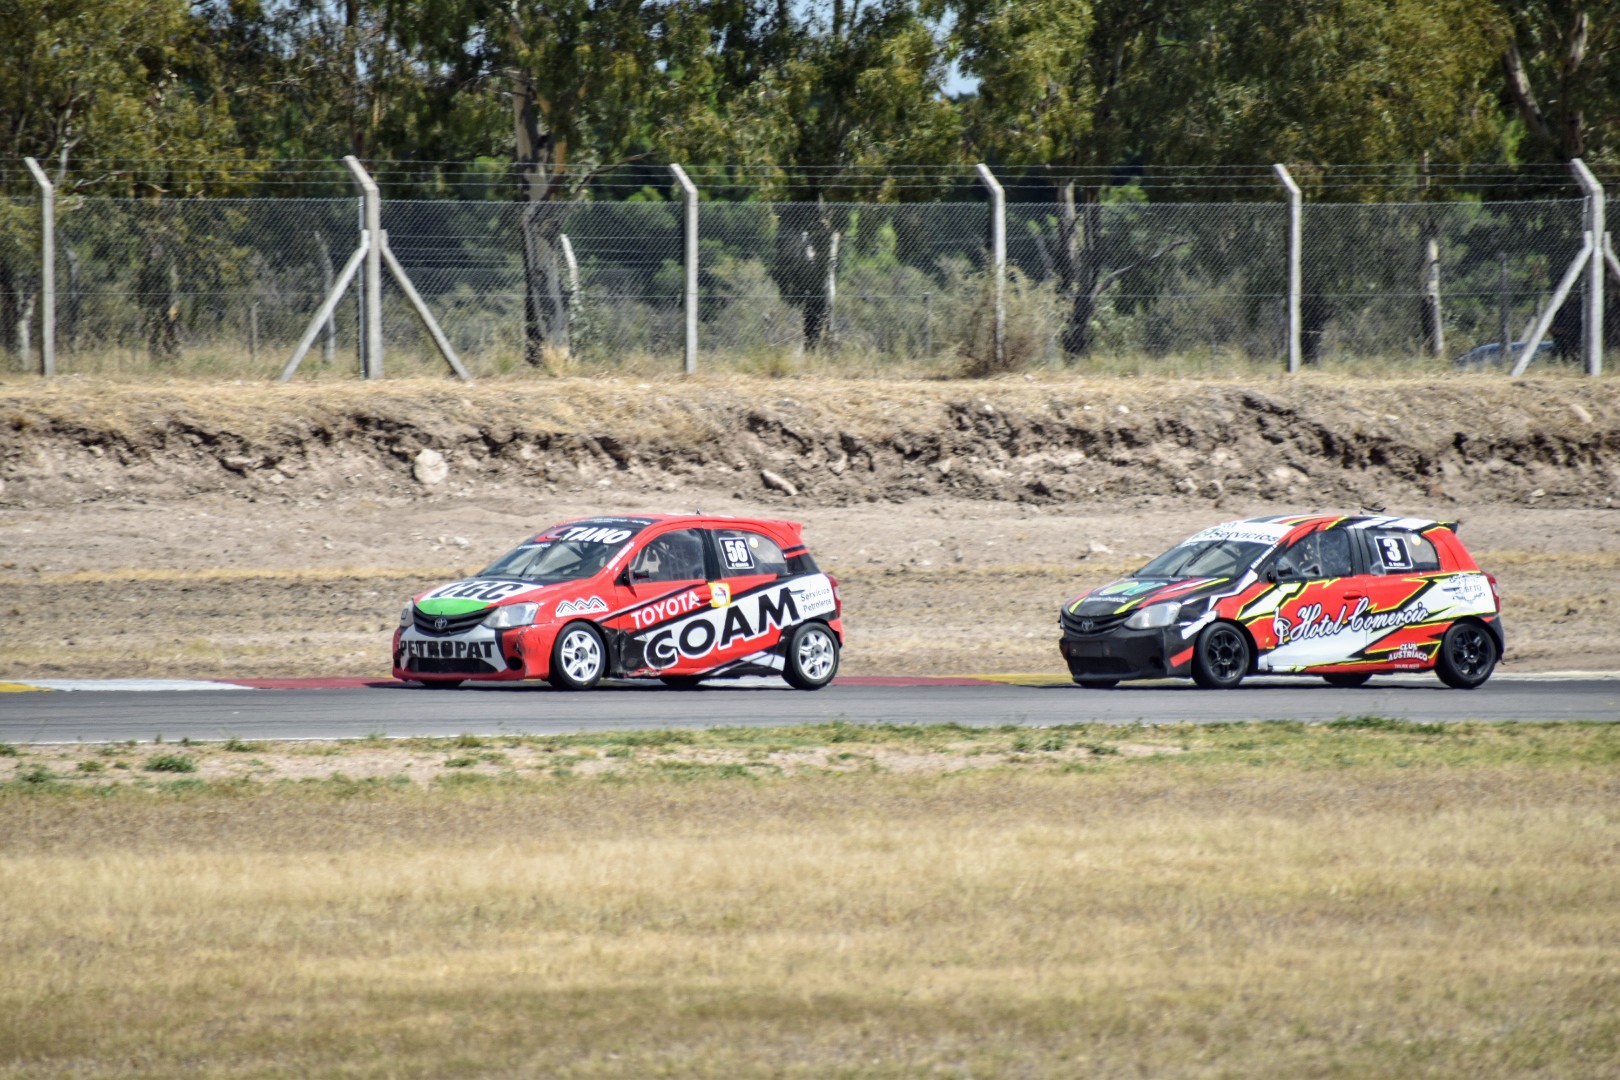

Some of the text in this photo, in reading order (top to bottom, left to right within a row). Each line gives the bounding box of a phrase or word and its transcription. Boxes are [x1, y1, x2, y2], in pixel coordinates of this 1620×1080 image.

[562, 527, 632, 544] TANO
[724, 540, 748, 563] 56
[1383, 538, 1402, 562] 3
[800, 588, 830, 602] Servicios
[631, 590, 701, 629] TOYOTA
[802, 598, 832, 613] Petroleros
[644, 586, 802, 669] COAM
[1290, 596, 1429, 642] Hotel Comercio
[398, 640, 495, 658] PETROPAT
[1400, 643, 1418, 651] CLUB
